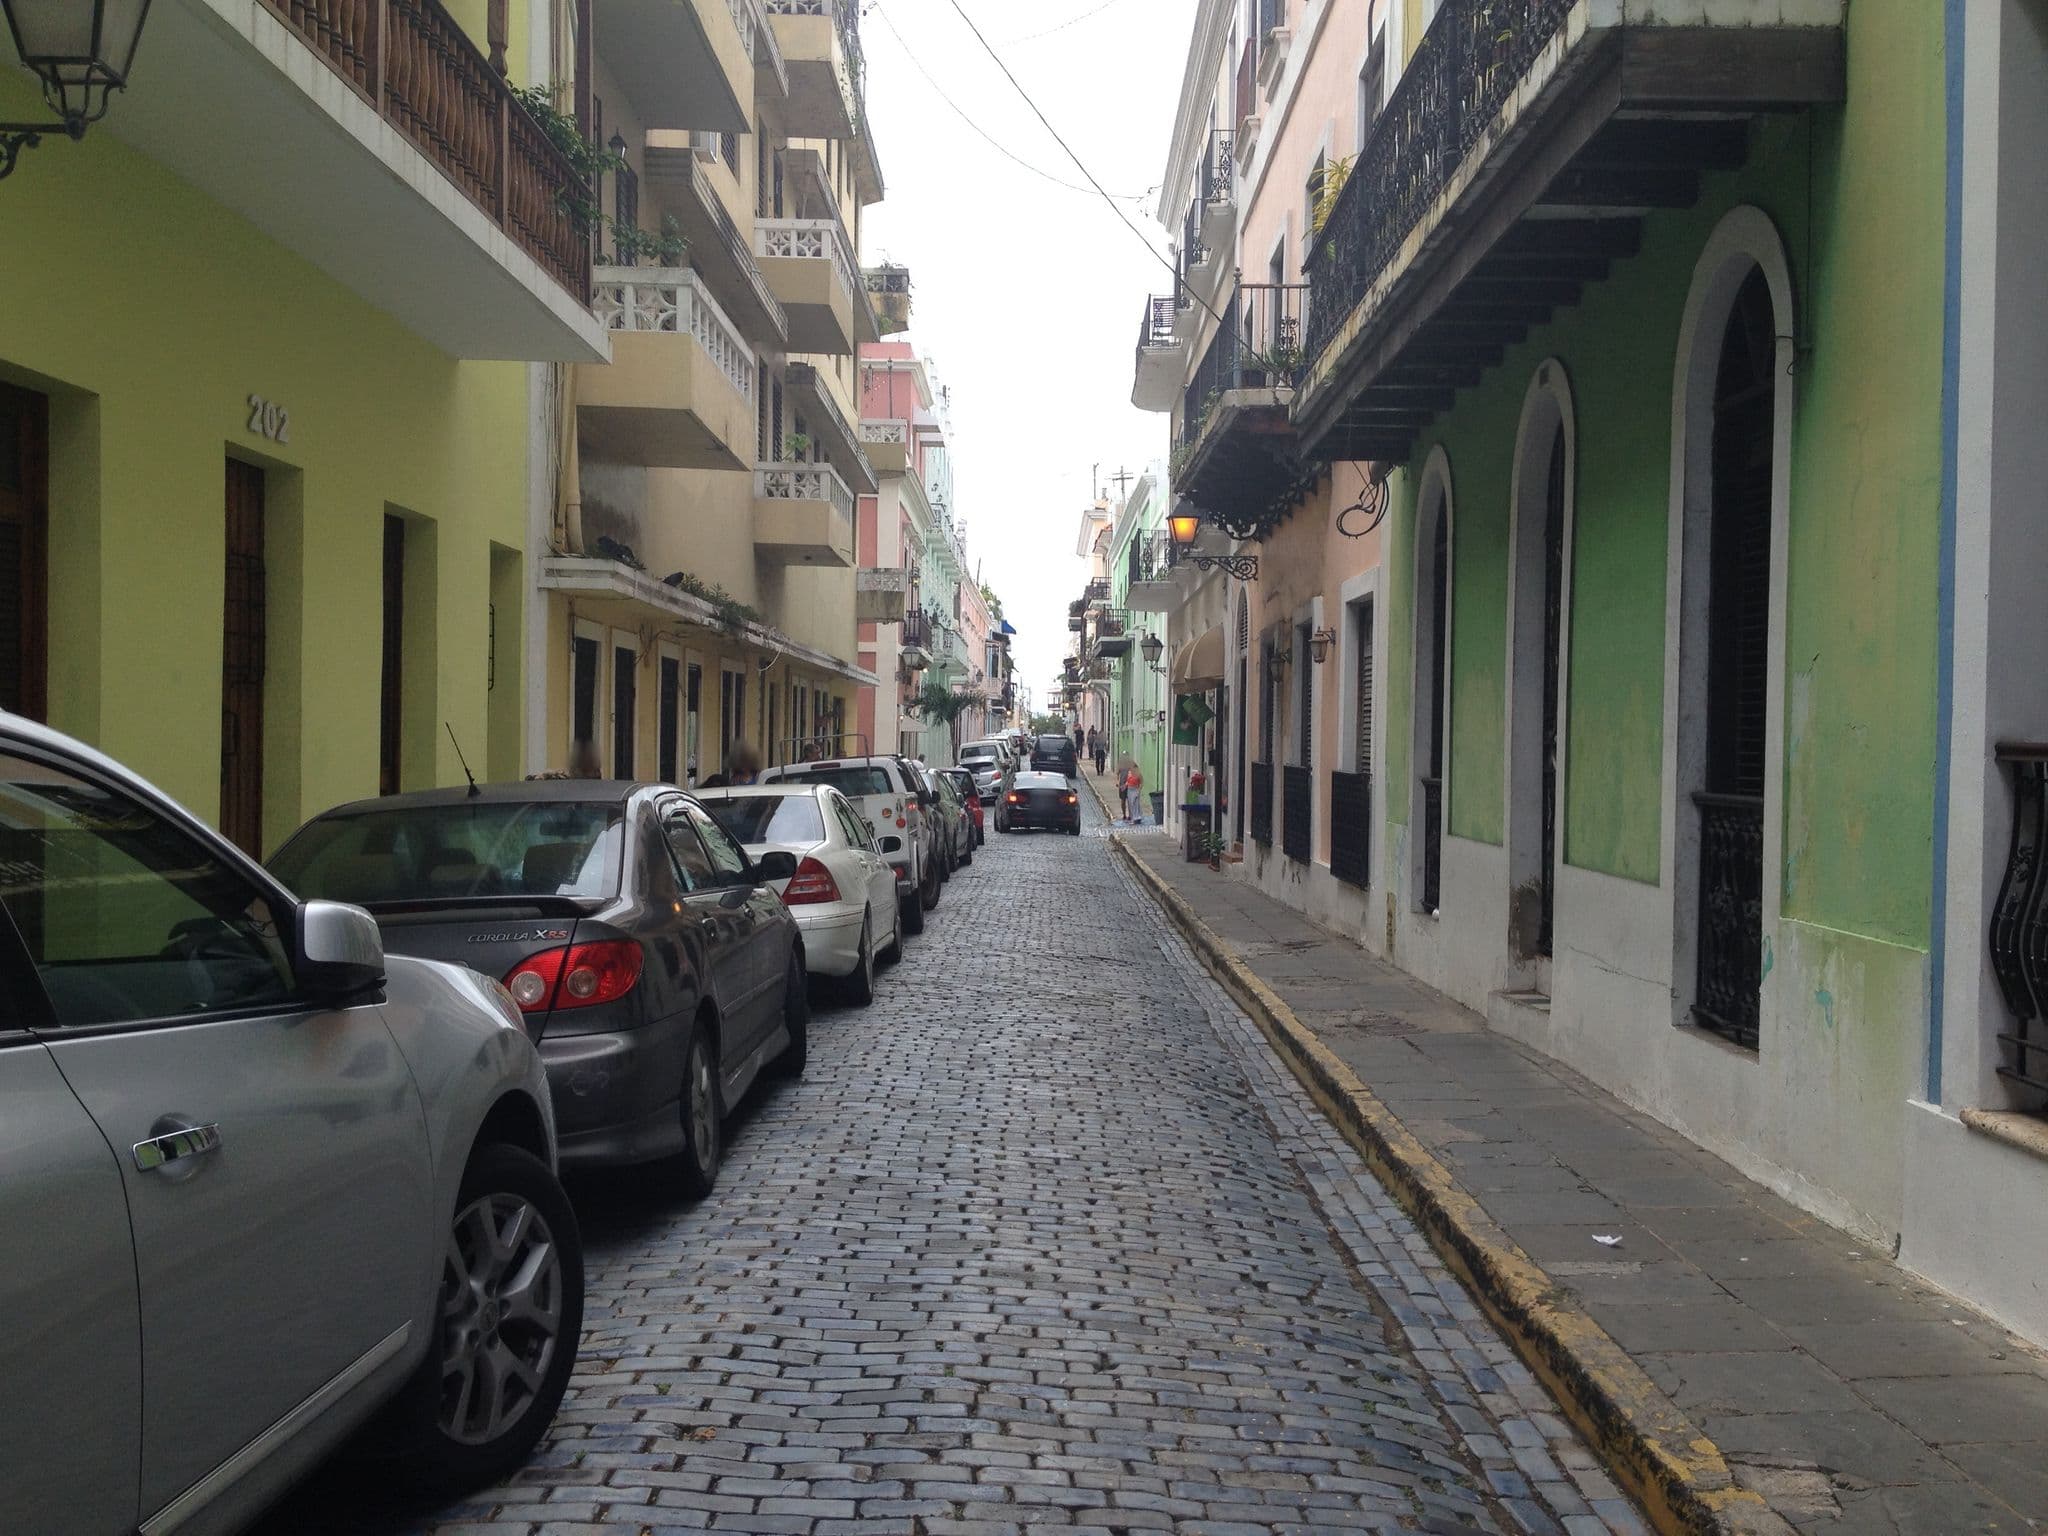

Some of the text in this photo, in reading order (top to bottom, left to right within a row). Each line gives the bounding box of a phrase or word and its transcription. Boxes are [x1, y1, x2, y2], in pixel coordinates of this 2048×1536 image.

[247, 394, 289, 444] 202
[467, 929, 568, 942] COROLLA XRS
